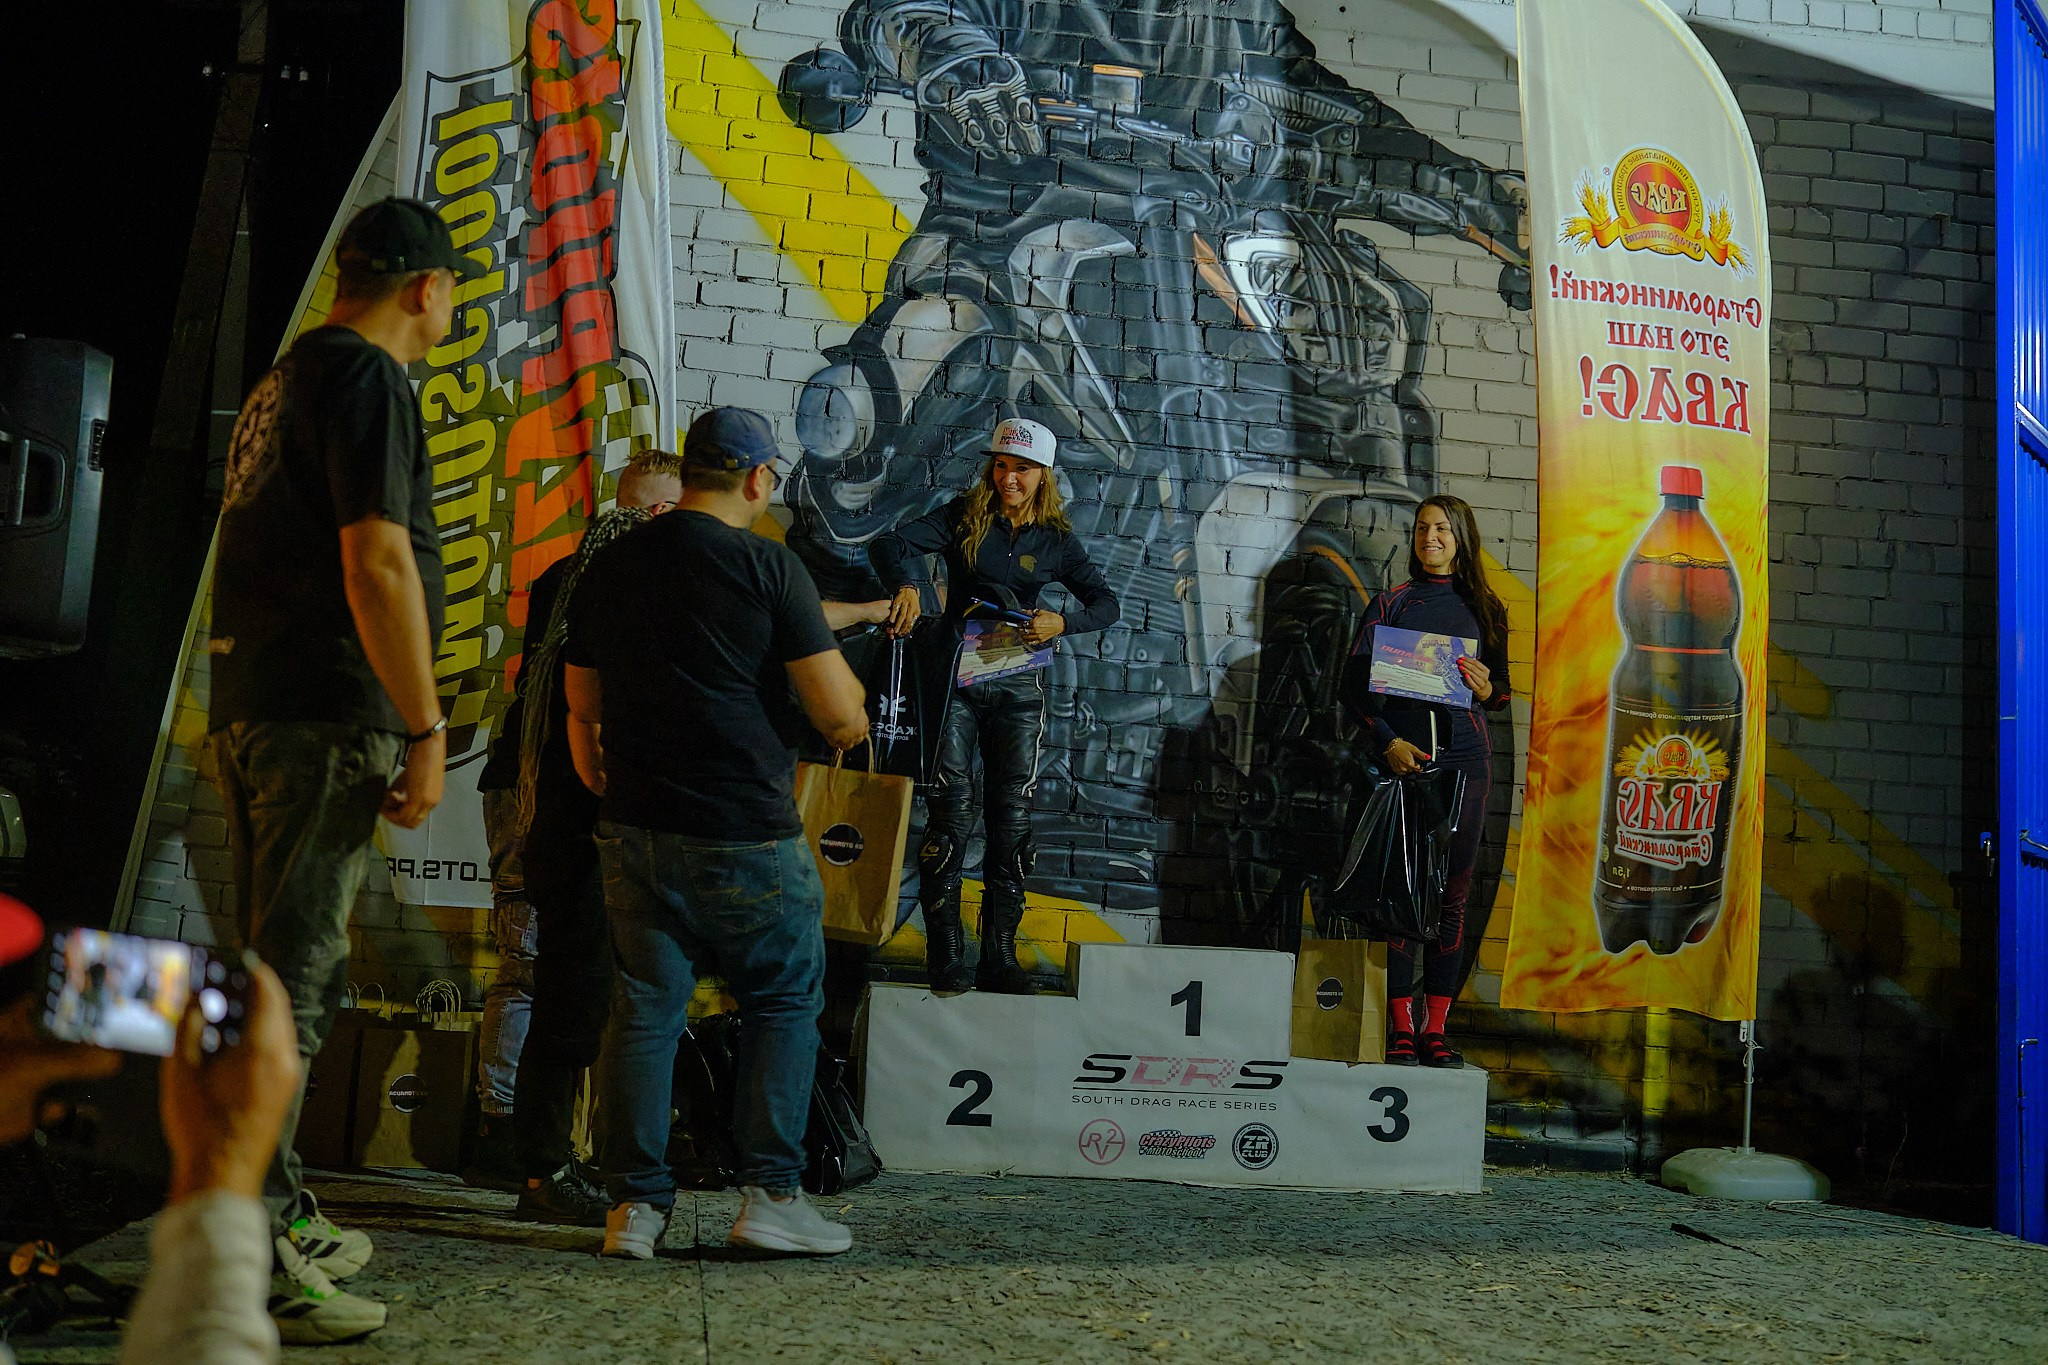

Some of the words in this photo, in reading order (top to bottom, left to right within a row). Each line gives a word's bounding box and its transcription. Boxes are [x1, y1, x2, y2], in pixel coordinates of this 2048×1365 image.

[1170, 980, 1203, 1037] 1
[1073, 1053, 1289, 1090] SDRS
[946, 1070, 993, 1127] 2
[1072, 1095, 1123, 1105] SOUTH
[1131, 1097, 1171, 1107] DRAG
[1178, 1099, 1217, 1109] RACE
[1224, 1101, 1278, 1111] SERIES
[1366, 1086, 1410, 1143] 3
[1139, 1133, 1216, 1149] CrazyPilots
[1241, 1135, 1270, 1149] ZR
[1241, 1149, 1269, 1158] CLUB
